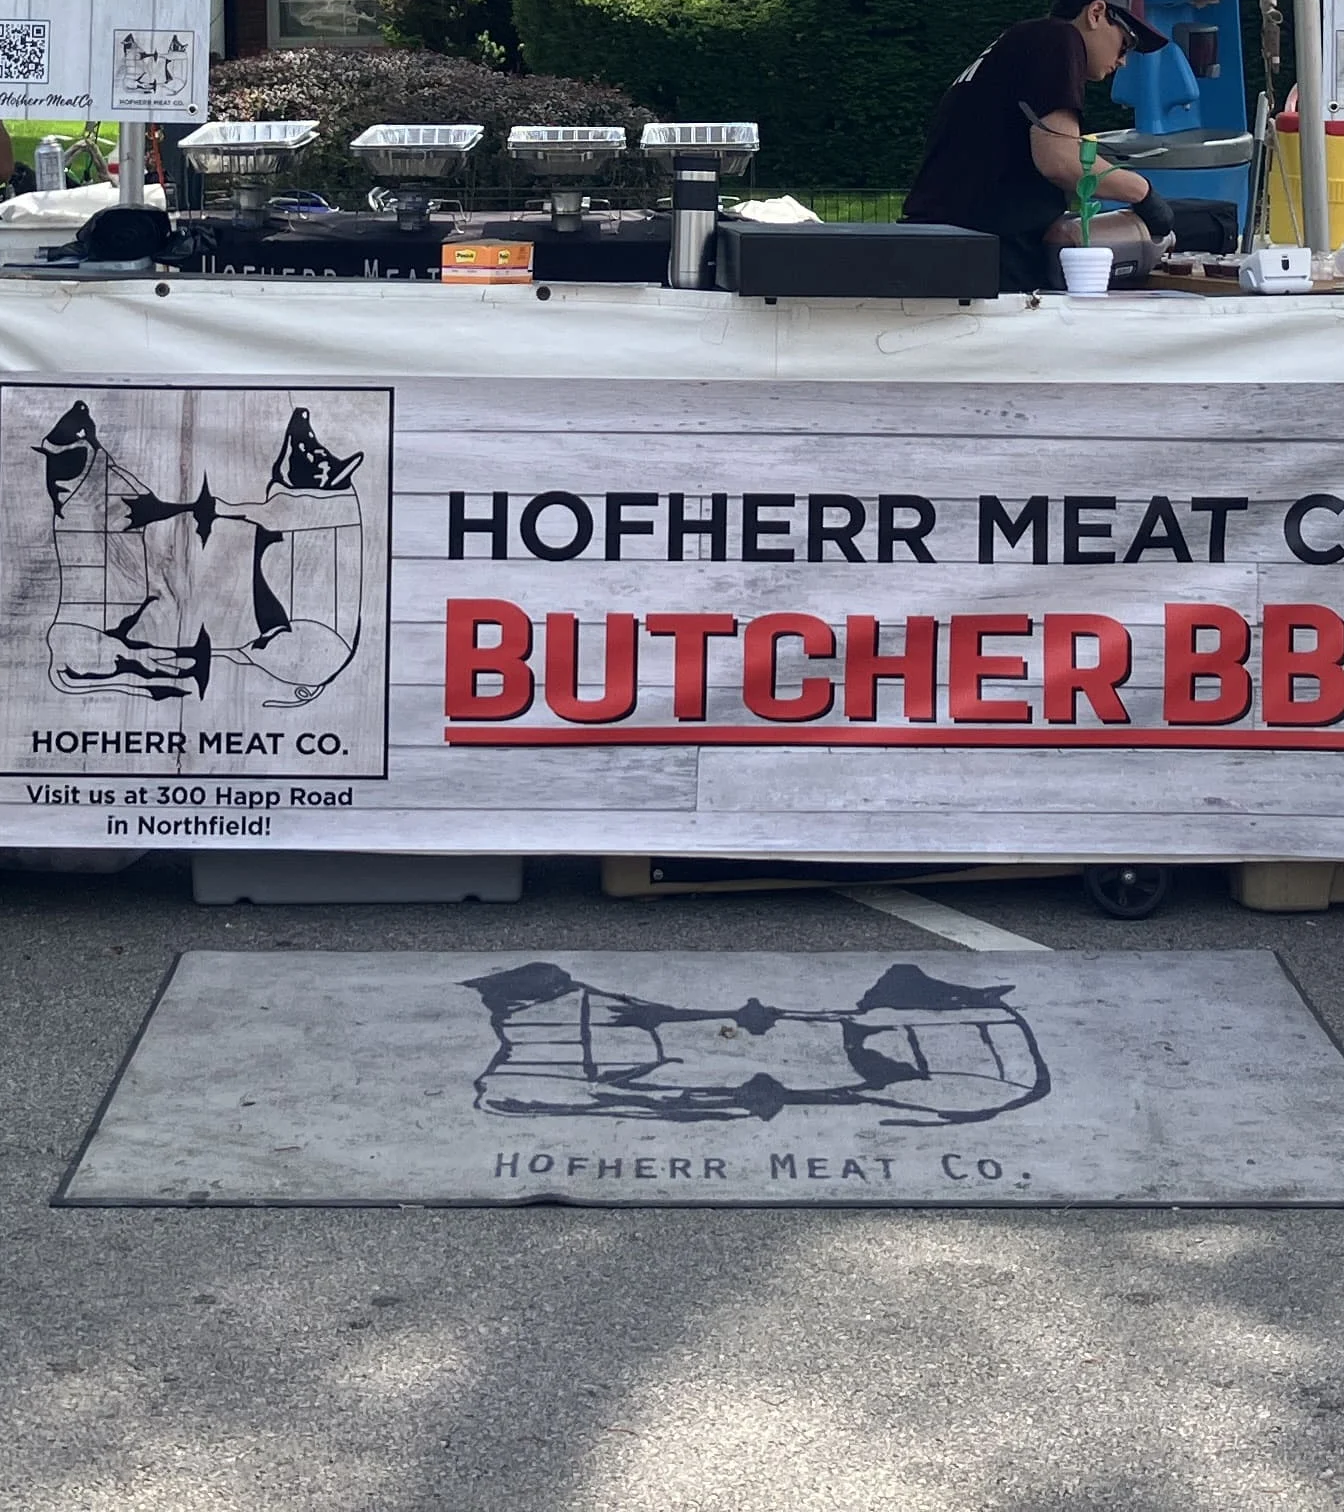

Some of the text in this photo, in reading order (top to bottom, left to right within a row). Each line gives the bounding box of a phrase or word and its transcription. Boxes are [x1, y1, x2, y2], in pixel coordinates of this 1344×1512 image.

[447, 490, 933, 564] HOFHERR
[978, 494, 1249, 565] MEAT
[444, 598, 1133, 724] BUTCHER
[32, 731, 349, 756] HOFHERR MEAT CO.
[26, 784, 353, 809] Visit us at 300 Happ Road
[106, 815, 272, 836] in Northfield!
[494, 1151, 1033, 1181] HOFHERR MEAT CO.
